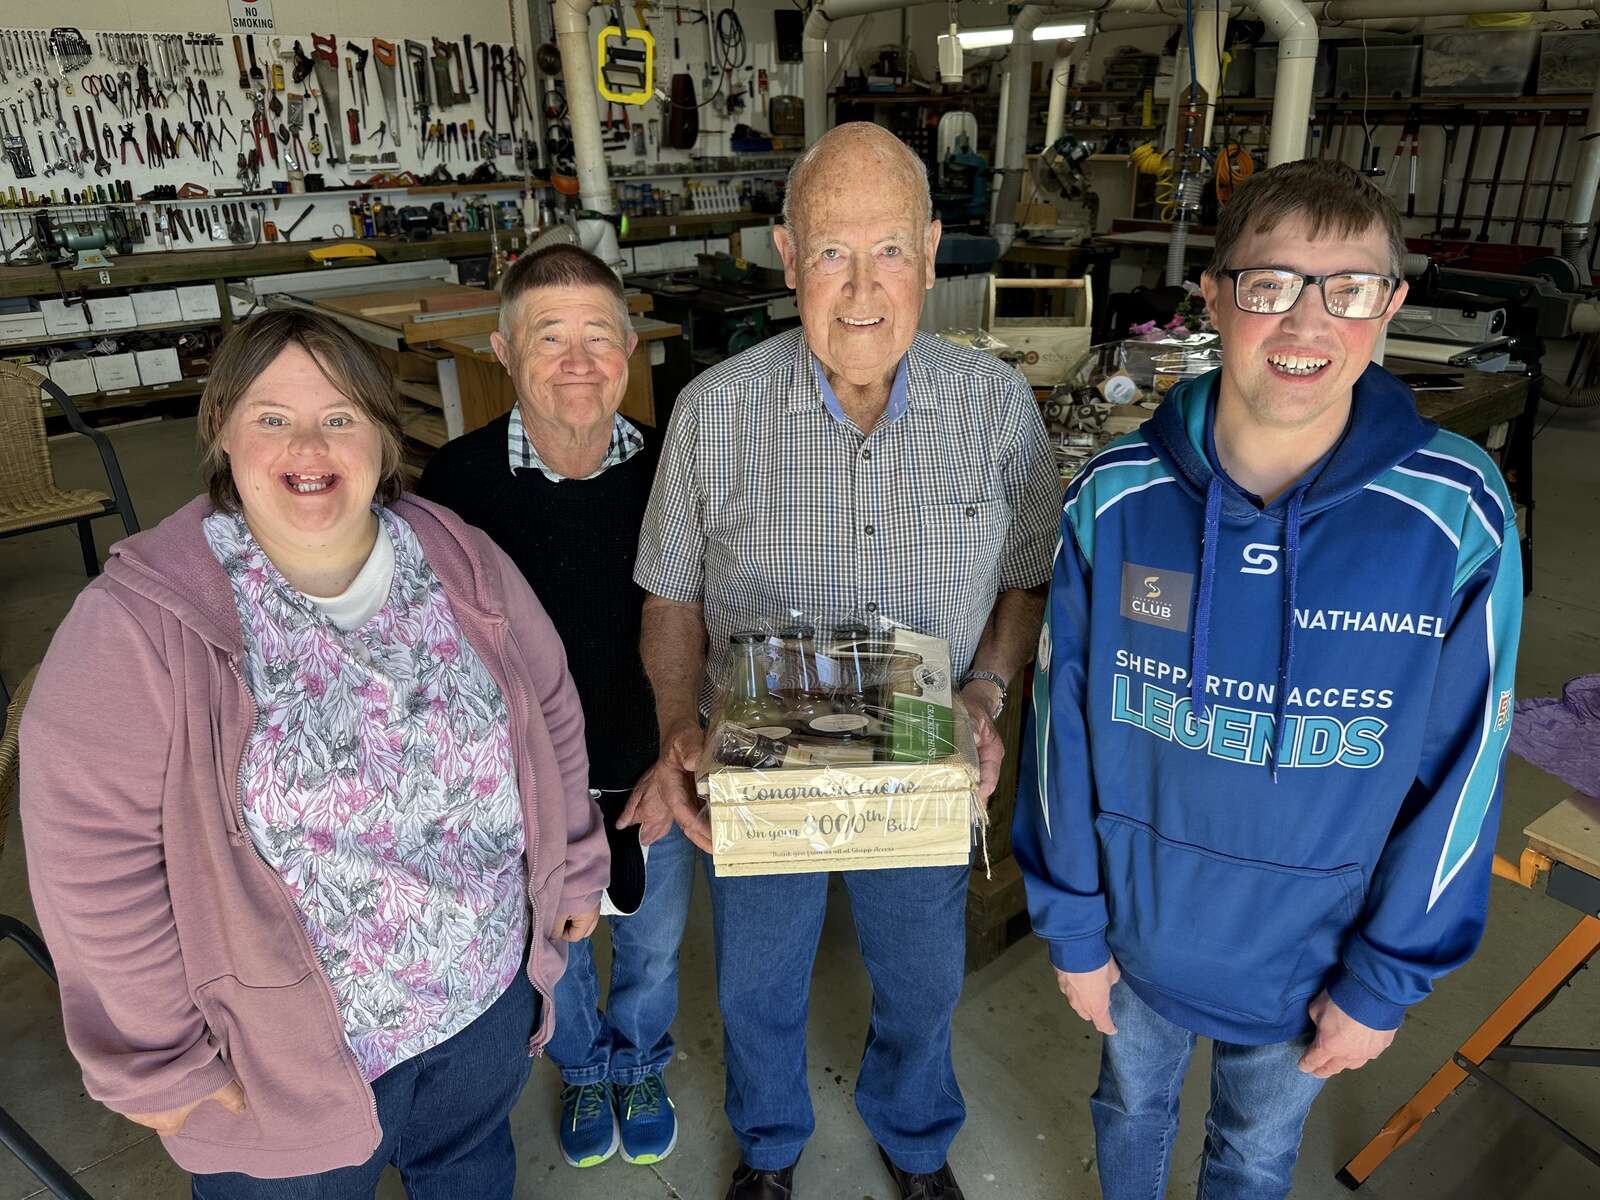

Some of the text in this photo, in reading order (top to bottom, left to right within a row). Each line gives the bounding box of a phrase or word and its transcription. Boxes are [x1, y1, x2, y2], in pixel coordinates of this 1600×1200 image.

[233, 18, 273, 28] SMOKING
[245, 7, 257, 17] NO
[1132, 600, 1172, 618] CLUB
[1293, 609, 1446, 638] NATHANAEL
[1115, 650, 1394, 709] SHEPPRTON ACCESS
[1112, 673, 1388, 769] LEGENDS
